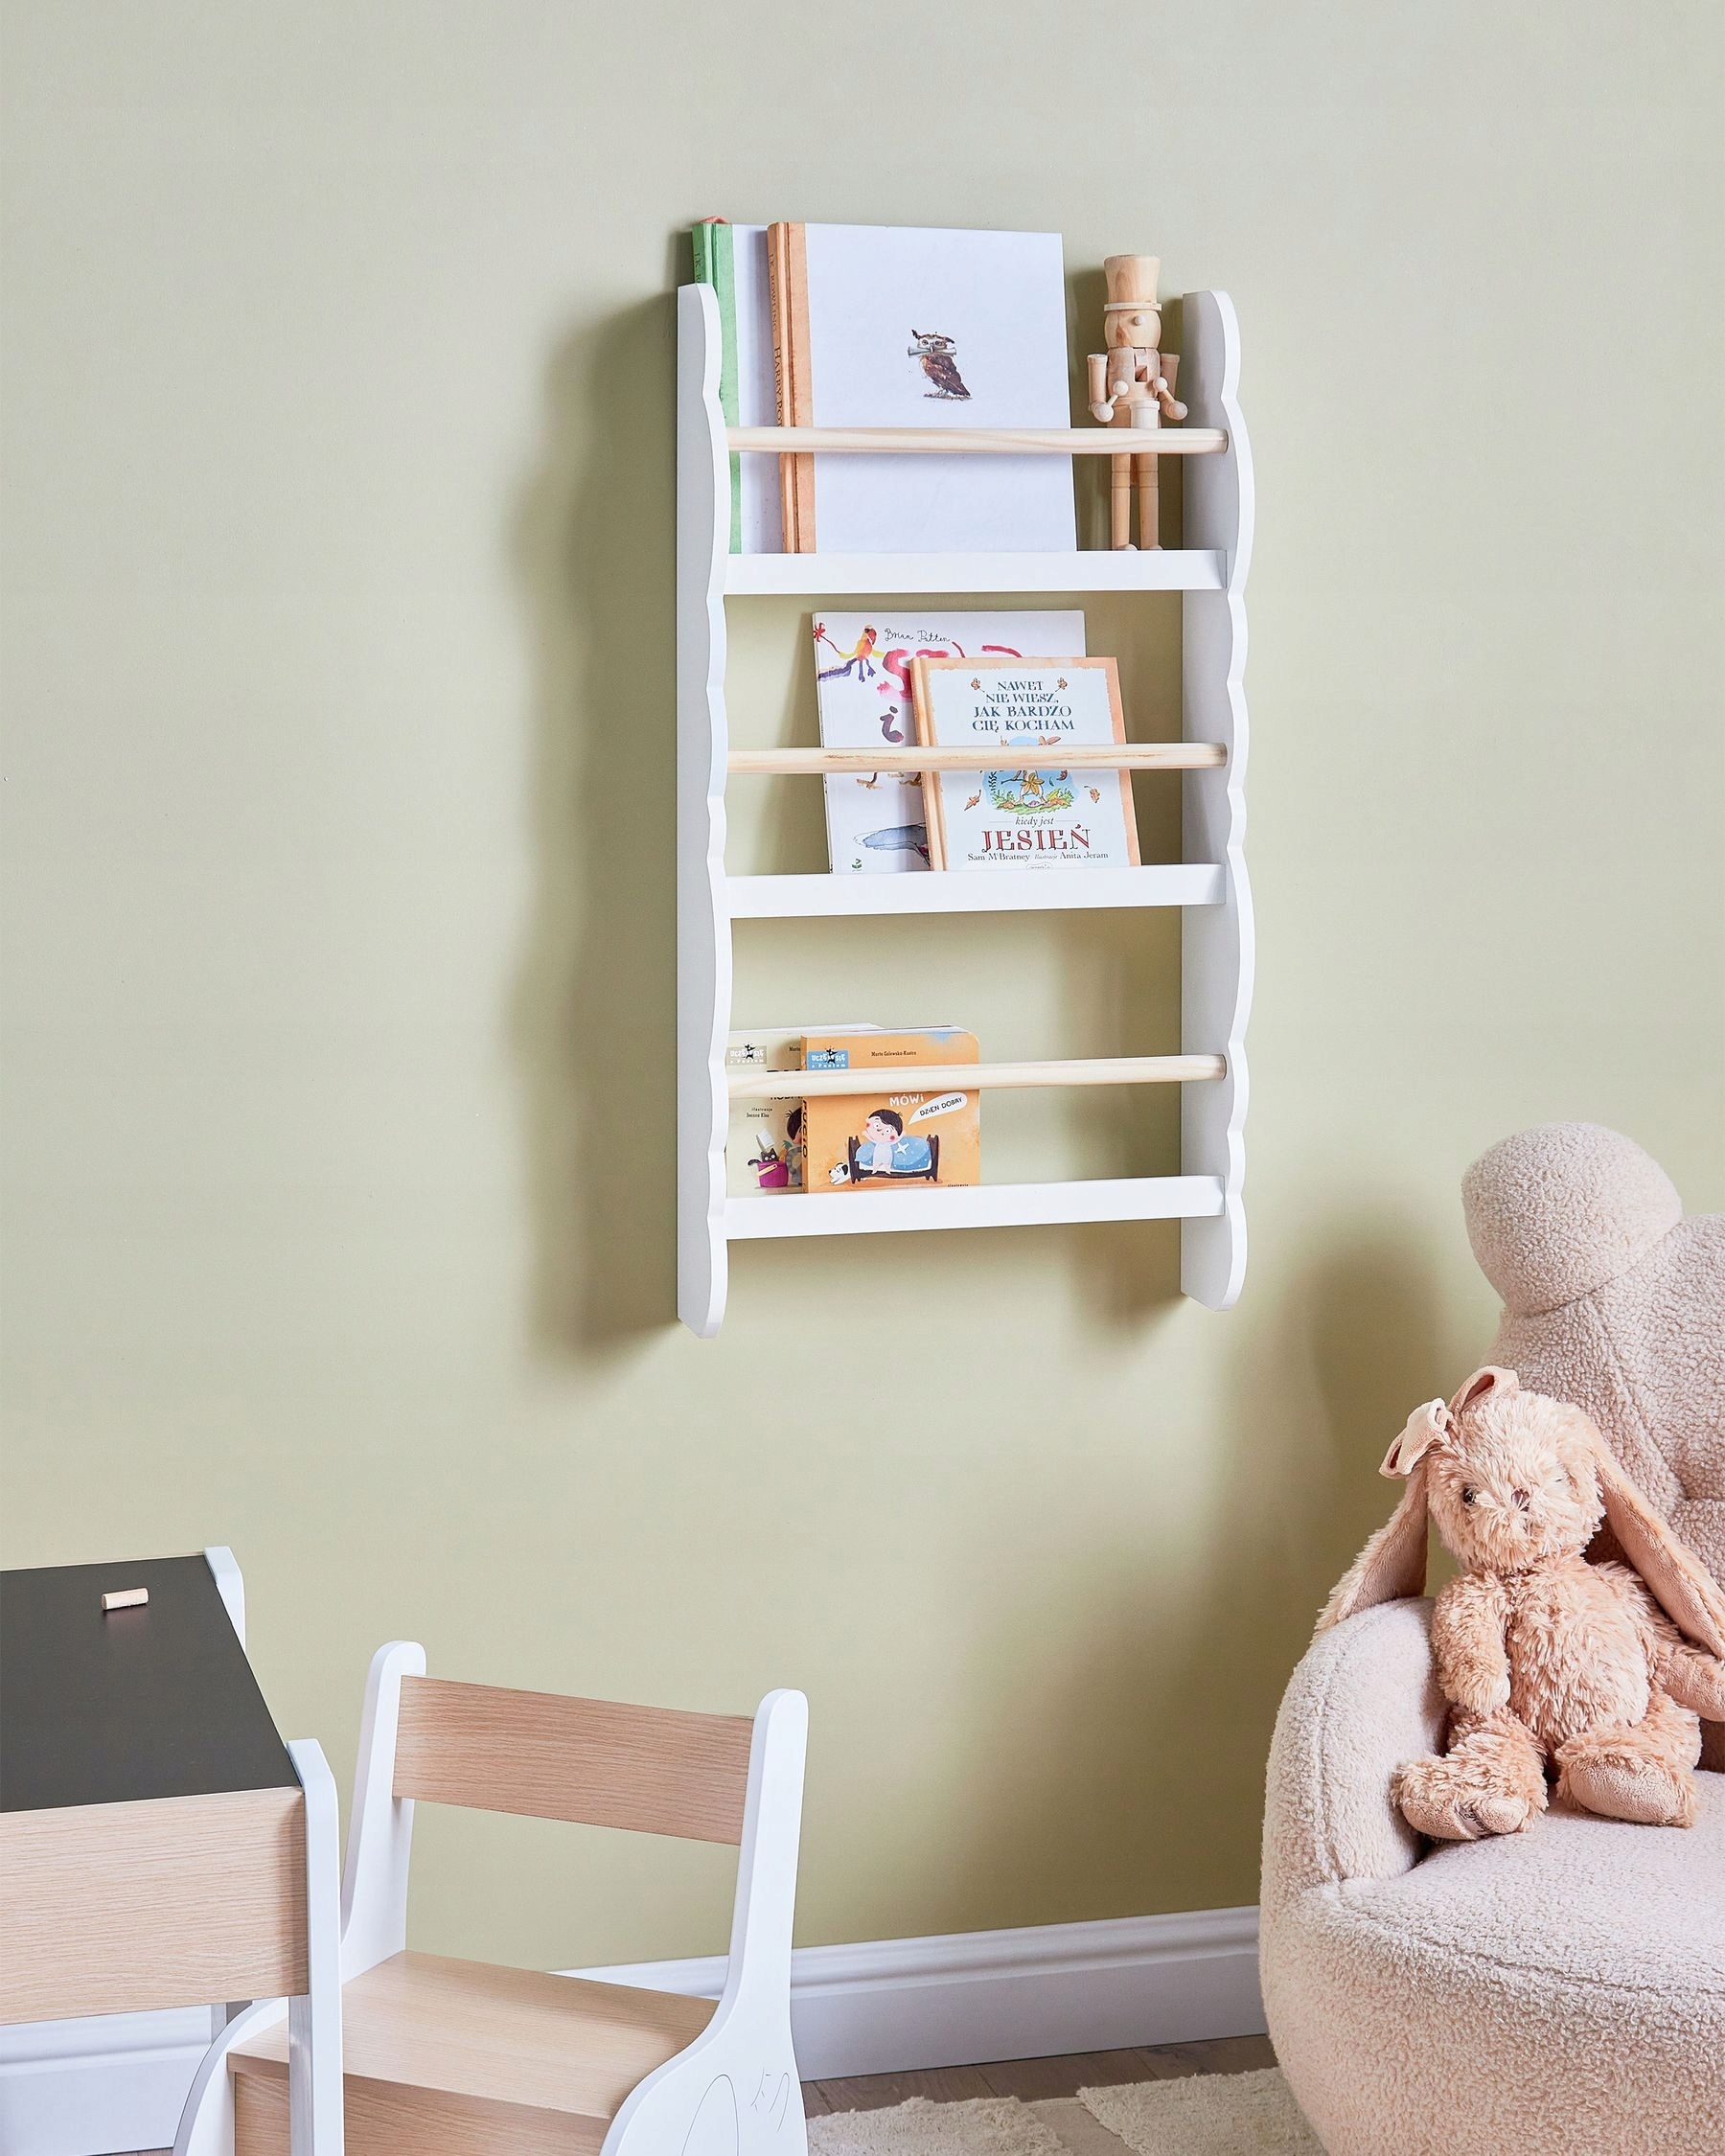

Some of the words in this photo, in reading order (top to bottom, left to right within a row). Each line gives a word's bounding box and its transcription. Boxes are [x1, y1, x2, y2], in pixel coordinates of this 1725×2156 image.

[770, 275, 778, 333] ROWLING
[774, 347, 783, 397] HARRY
[885, 628, 915, 642] Brian
[917, 630, 952, 643] Patten
[997, 680, 1045, 691] NAWET
[985, 693, 1010, 704] NIE
[1012, 693, 1060, 705] WIESZ,
[972, 705, 1000, 719] JAK
[1006, 705, 1072, 718] BARDZO
[972, 719, 1000, 733] CIĘ
[1004, 719, 1075, 731] KOCHAM
[1015, 816, 1038, 829] kiedy
[1038, 816, 1054, 827] jest
[981, 823, 1092, 853] JESIEŃ
[967, 852, 986, 861] Sam
[1059, 851, 1082, 860] Anita
[1083, 851, 1110, 860] Jeram
